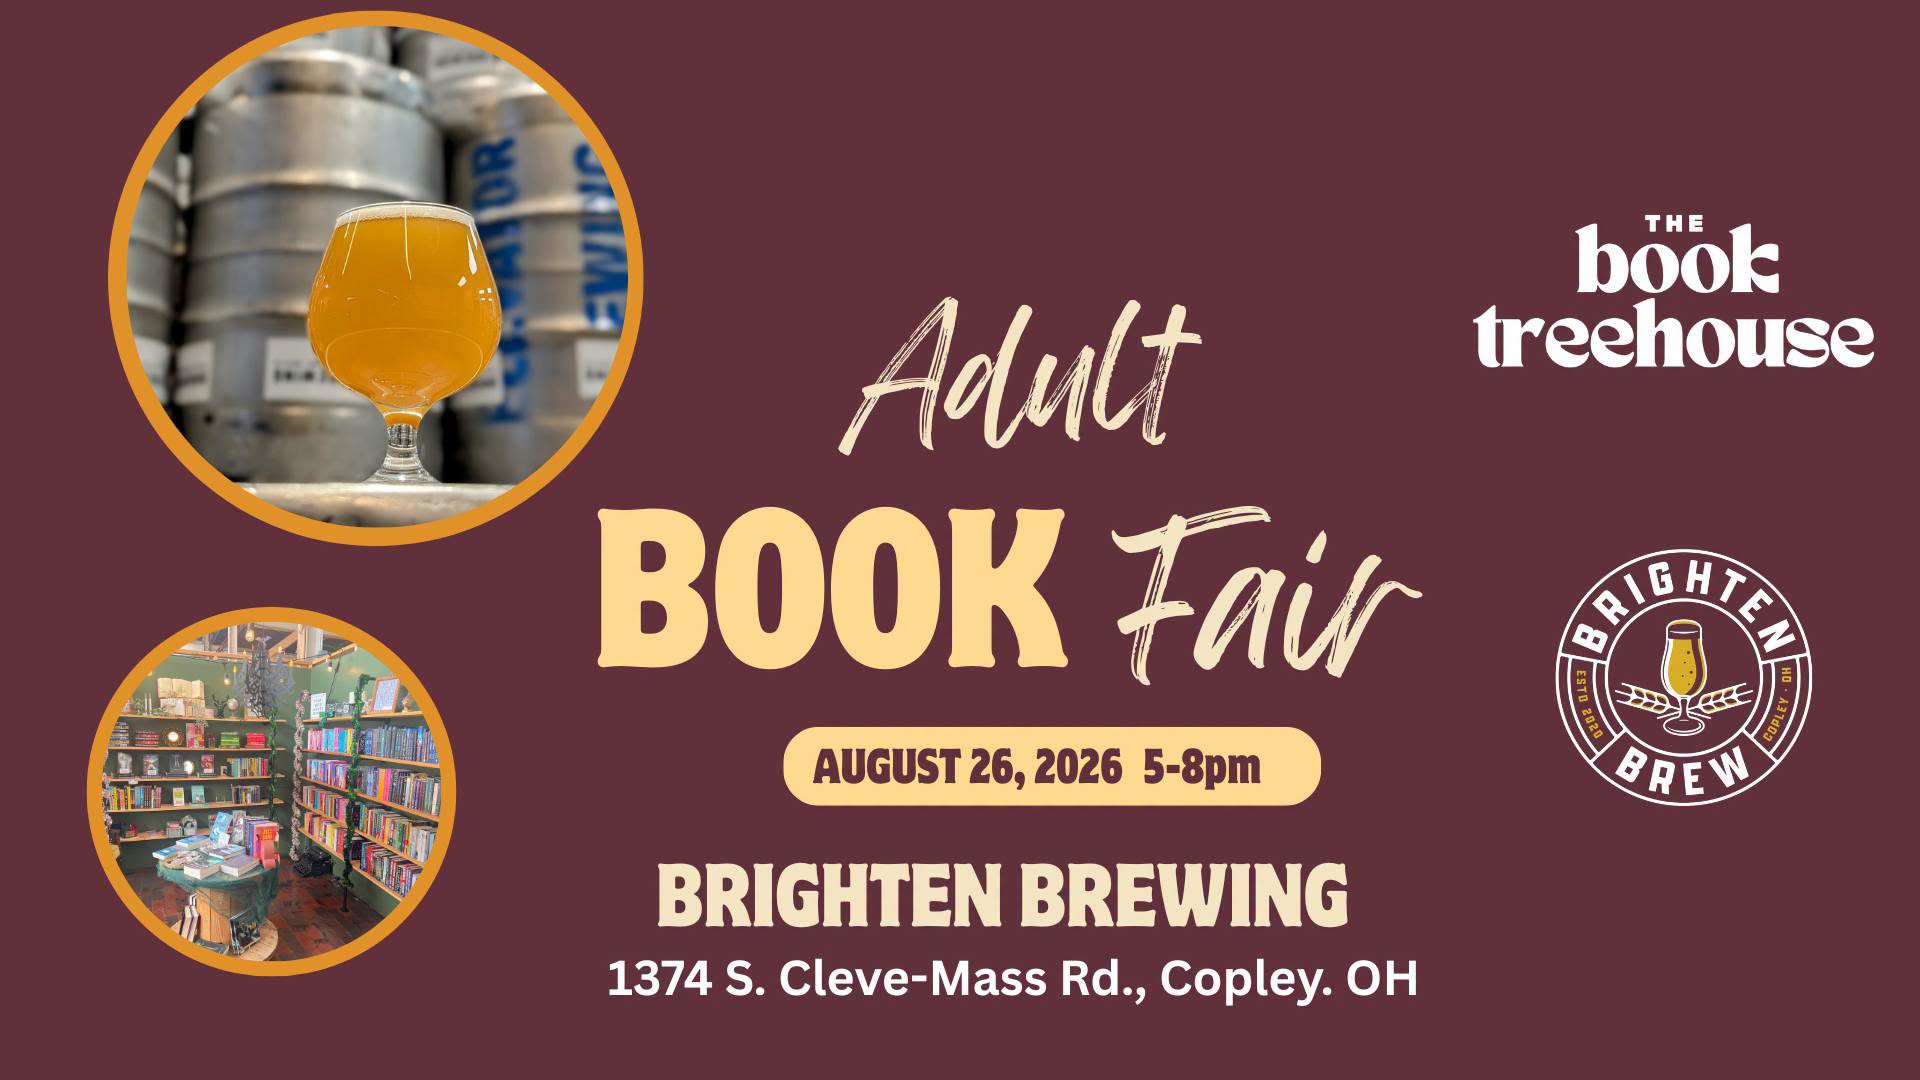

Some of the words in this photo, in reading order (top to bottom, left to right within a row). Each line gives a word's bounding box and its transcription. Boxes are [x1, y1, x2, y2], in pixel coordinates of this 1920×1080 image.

[1645, 215, 1704, 232] THE
[1575, 222, 1780, 293] book
[1473, 298, 1875, 368] treehouse
[838, 296, 1202, 456] Adult
[598, 507, 1068, 669] BOOK
[1111, 506, 1423, 686] Fair
[1572, 560, 1796, 654] BRIGHTEN
[1576, 670, 1589, 702] ESTD
[1763, 697, 1789, 742] COPLEY
[1781, 667, 1792, 683] OH
[1582, 708, 1604, 739] 2020
[813, 748, 962, 784] AUGUST
[970, 748, 1026, 790] 26,
[1035, 748, 1123, 784] 2026
[1144, 748, 1261, 790] 5-8pm
[1615, 746, 1749, 795] BREW
[658, 863, 1002, 927] BRIGHTEN
[1021, 863, 1349, 927] BREWING
[609, 960, 712, 996] 1374
[726, 960, 764, 997] S.
[780, 958, 1046, 997] Cleve-Mass
[1063, 958, 1146, 1005] Rd.,
[1161, 958, 1332, 1006] Copley.
[1347, 960, 1416, 996] OH
